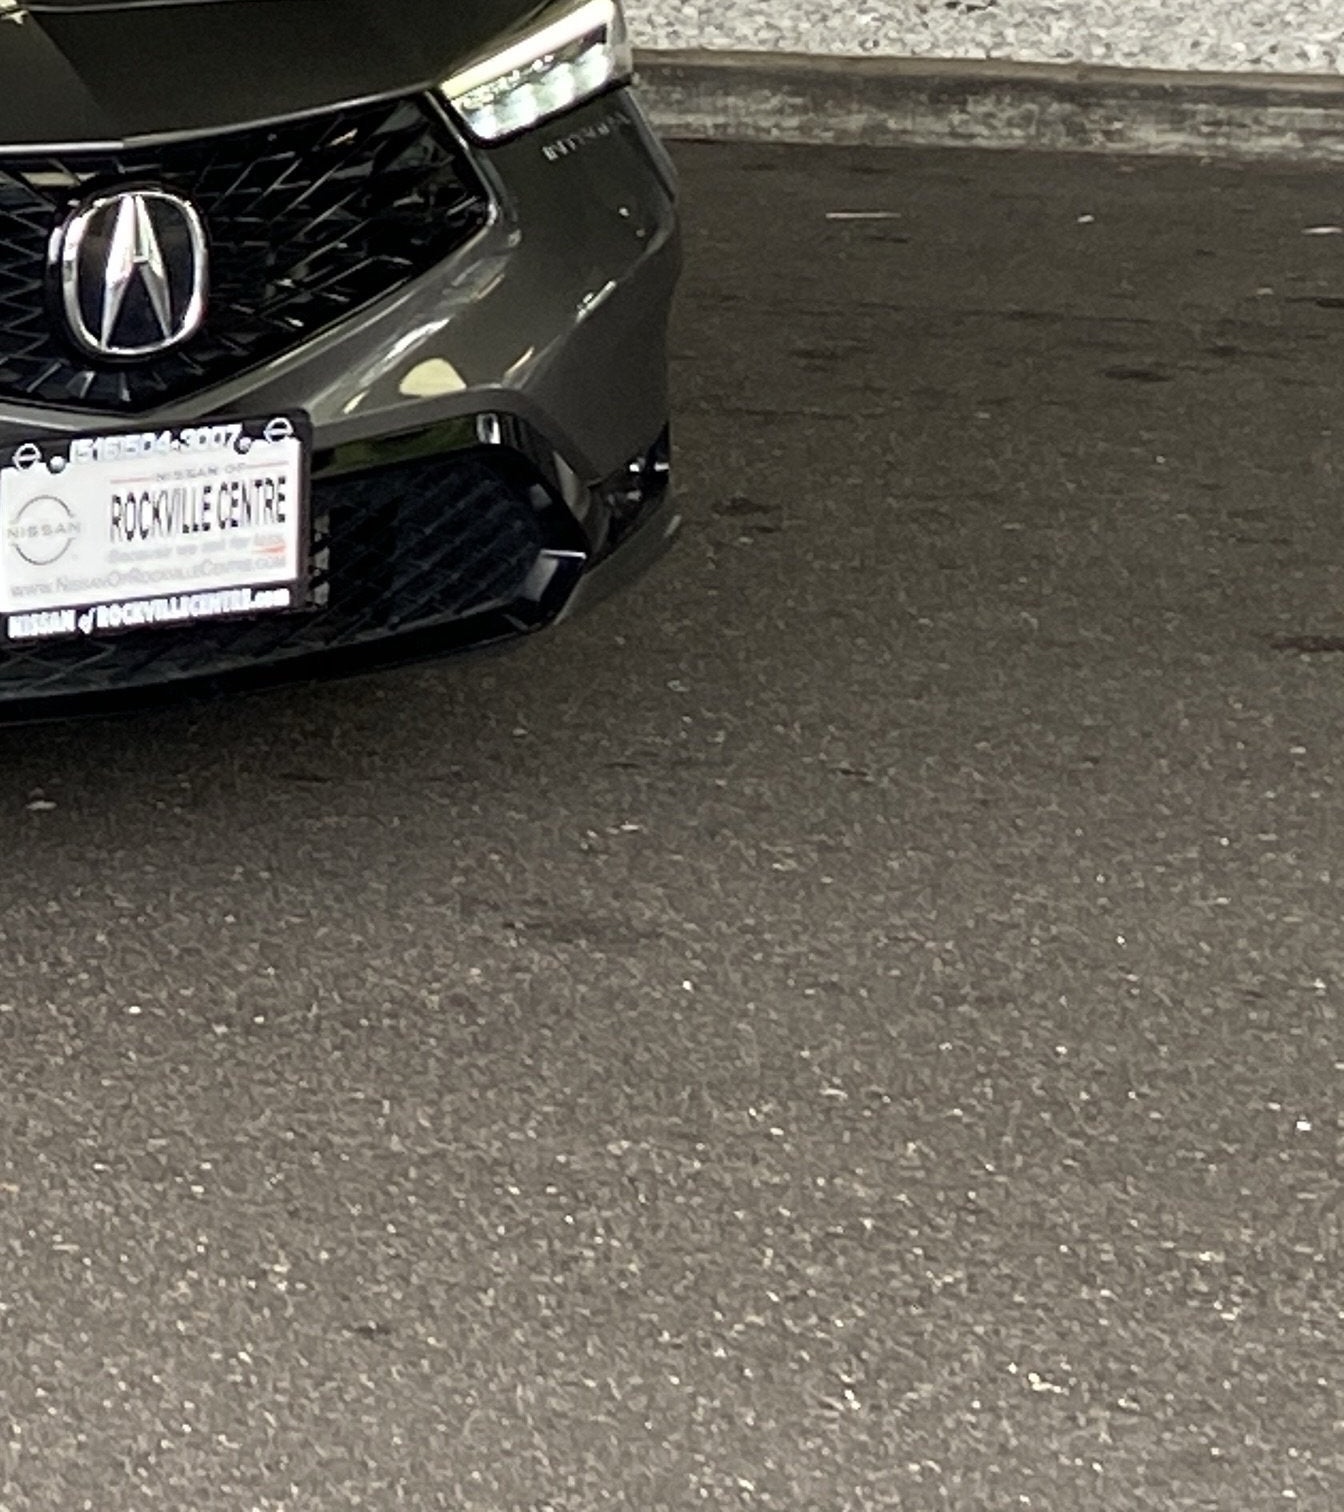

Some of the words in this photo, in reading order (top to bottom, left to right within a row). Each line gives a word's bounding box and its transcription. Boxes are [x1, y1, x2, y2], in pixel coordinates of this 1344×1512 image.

[7, 520, 81, 540] NISSAN
[109, 484, 212, 543] ROCKVILLE
[216, 475, 286, 531] CENTRE
